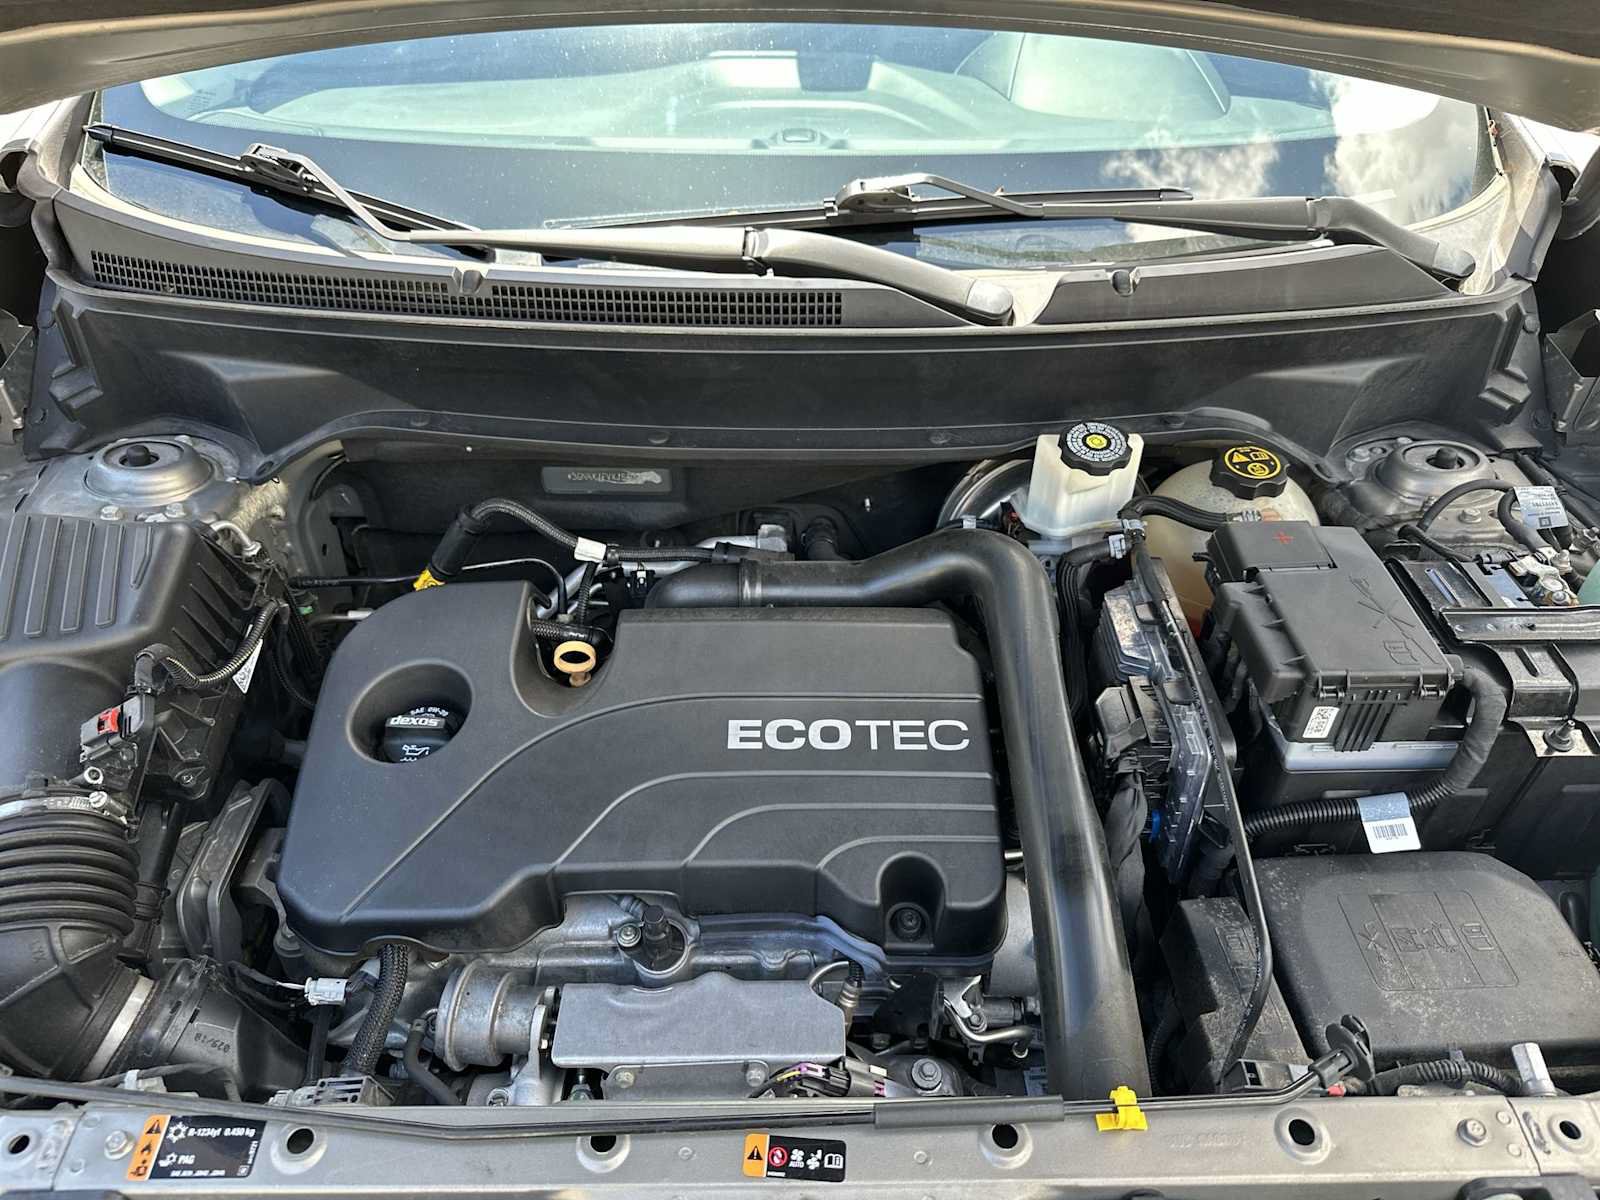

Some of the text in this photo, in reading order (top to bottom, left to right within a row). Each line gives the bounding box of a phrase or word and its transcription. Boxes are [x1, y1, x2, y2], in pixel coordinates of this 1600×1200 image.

[390, 715, 440, 727] dexos
[727, 718, 970, 751] ECOTEC
[177, 1155, 196, 1165] PAG
[789, 1160, 805, 1169] AUTO
